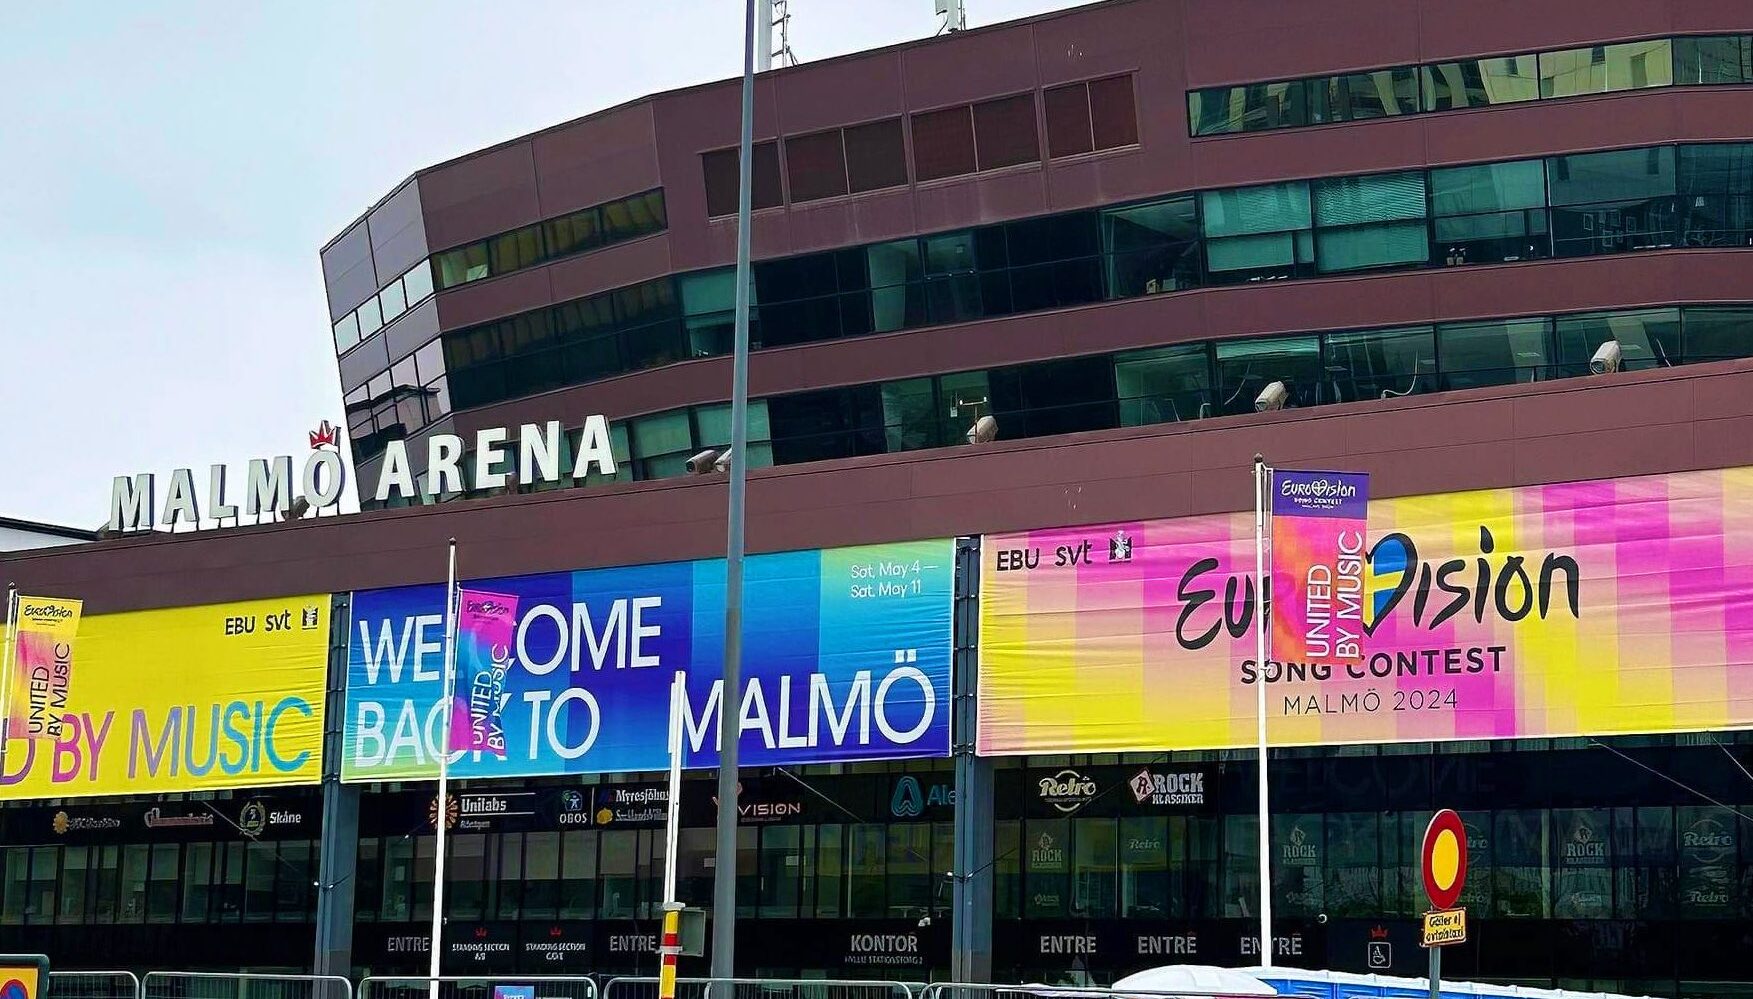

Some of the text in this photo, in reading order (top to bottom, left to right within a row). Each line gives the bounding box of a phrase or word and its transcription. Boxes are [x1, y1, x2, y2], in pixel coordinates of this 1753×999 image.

[375, 414, 616, 501] ARENA
[879, 562, 909, 579] May
[912, 560, 920, 574] 4
[997, 548, 1039, 571] EBU
[879, 582, 908, 598] May
[911, 580, 921, 594] 11
[1335, 530, 1363, 658] BY MUSIC
[1305, 564, 1333, 657] UNITED
[225, 616, 255, 635] EBU
[359, 596, 662, 684] WEOME
[1347, 646, 1506, 679] CONTEST
[28, 666, 50, 734] UNITED
[47, 642, 70, 736] BY MUSIC
[1283, 686, 1458, 715] MALMÖ 2024
[470, 671, 494, 745] UNITED
[523, 687, 601, 760] TO
[667, 649, 936, 753] MALMÖ
[52, 710, 115, 783] BY
[128, 696, 313, 779] MUSIC
[1153, 772, 1204, 793] ROCK
[461, 797, 507, 813] Unilabs
[1152, 793, 1204, 804] KLASSIKER
[559, 813, 587, 824] OBOS
[1566, 843, 1604, 857] ROCK
[851, 935, 918, 952] KONTOR
